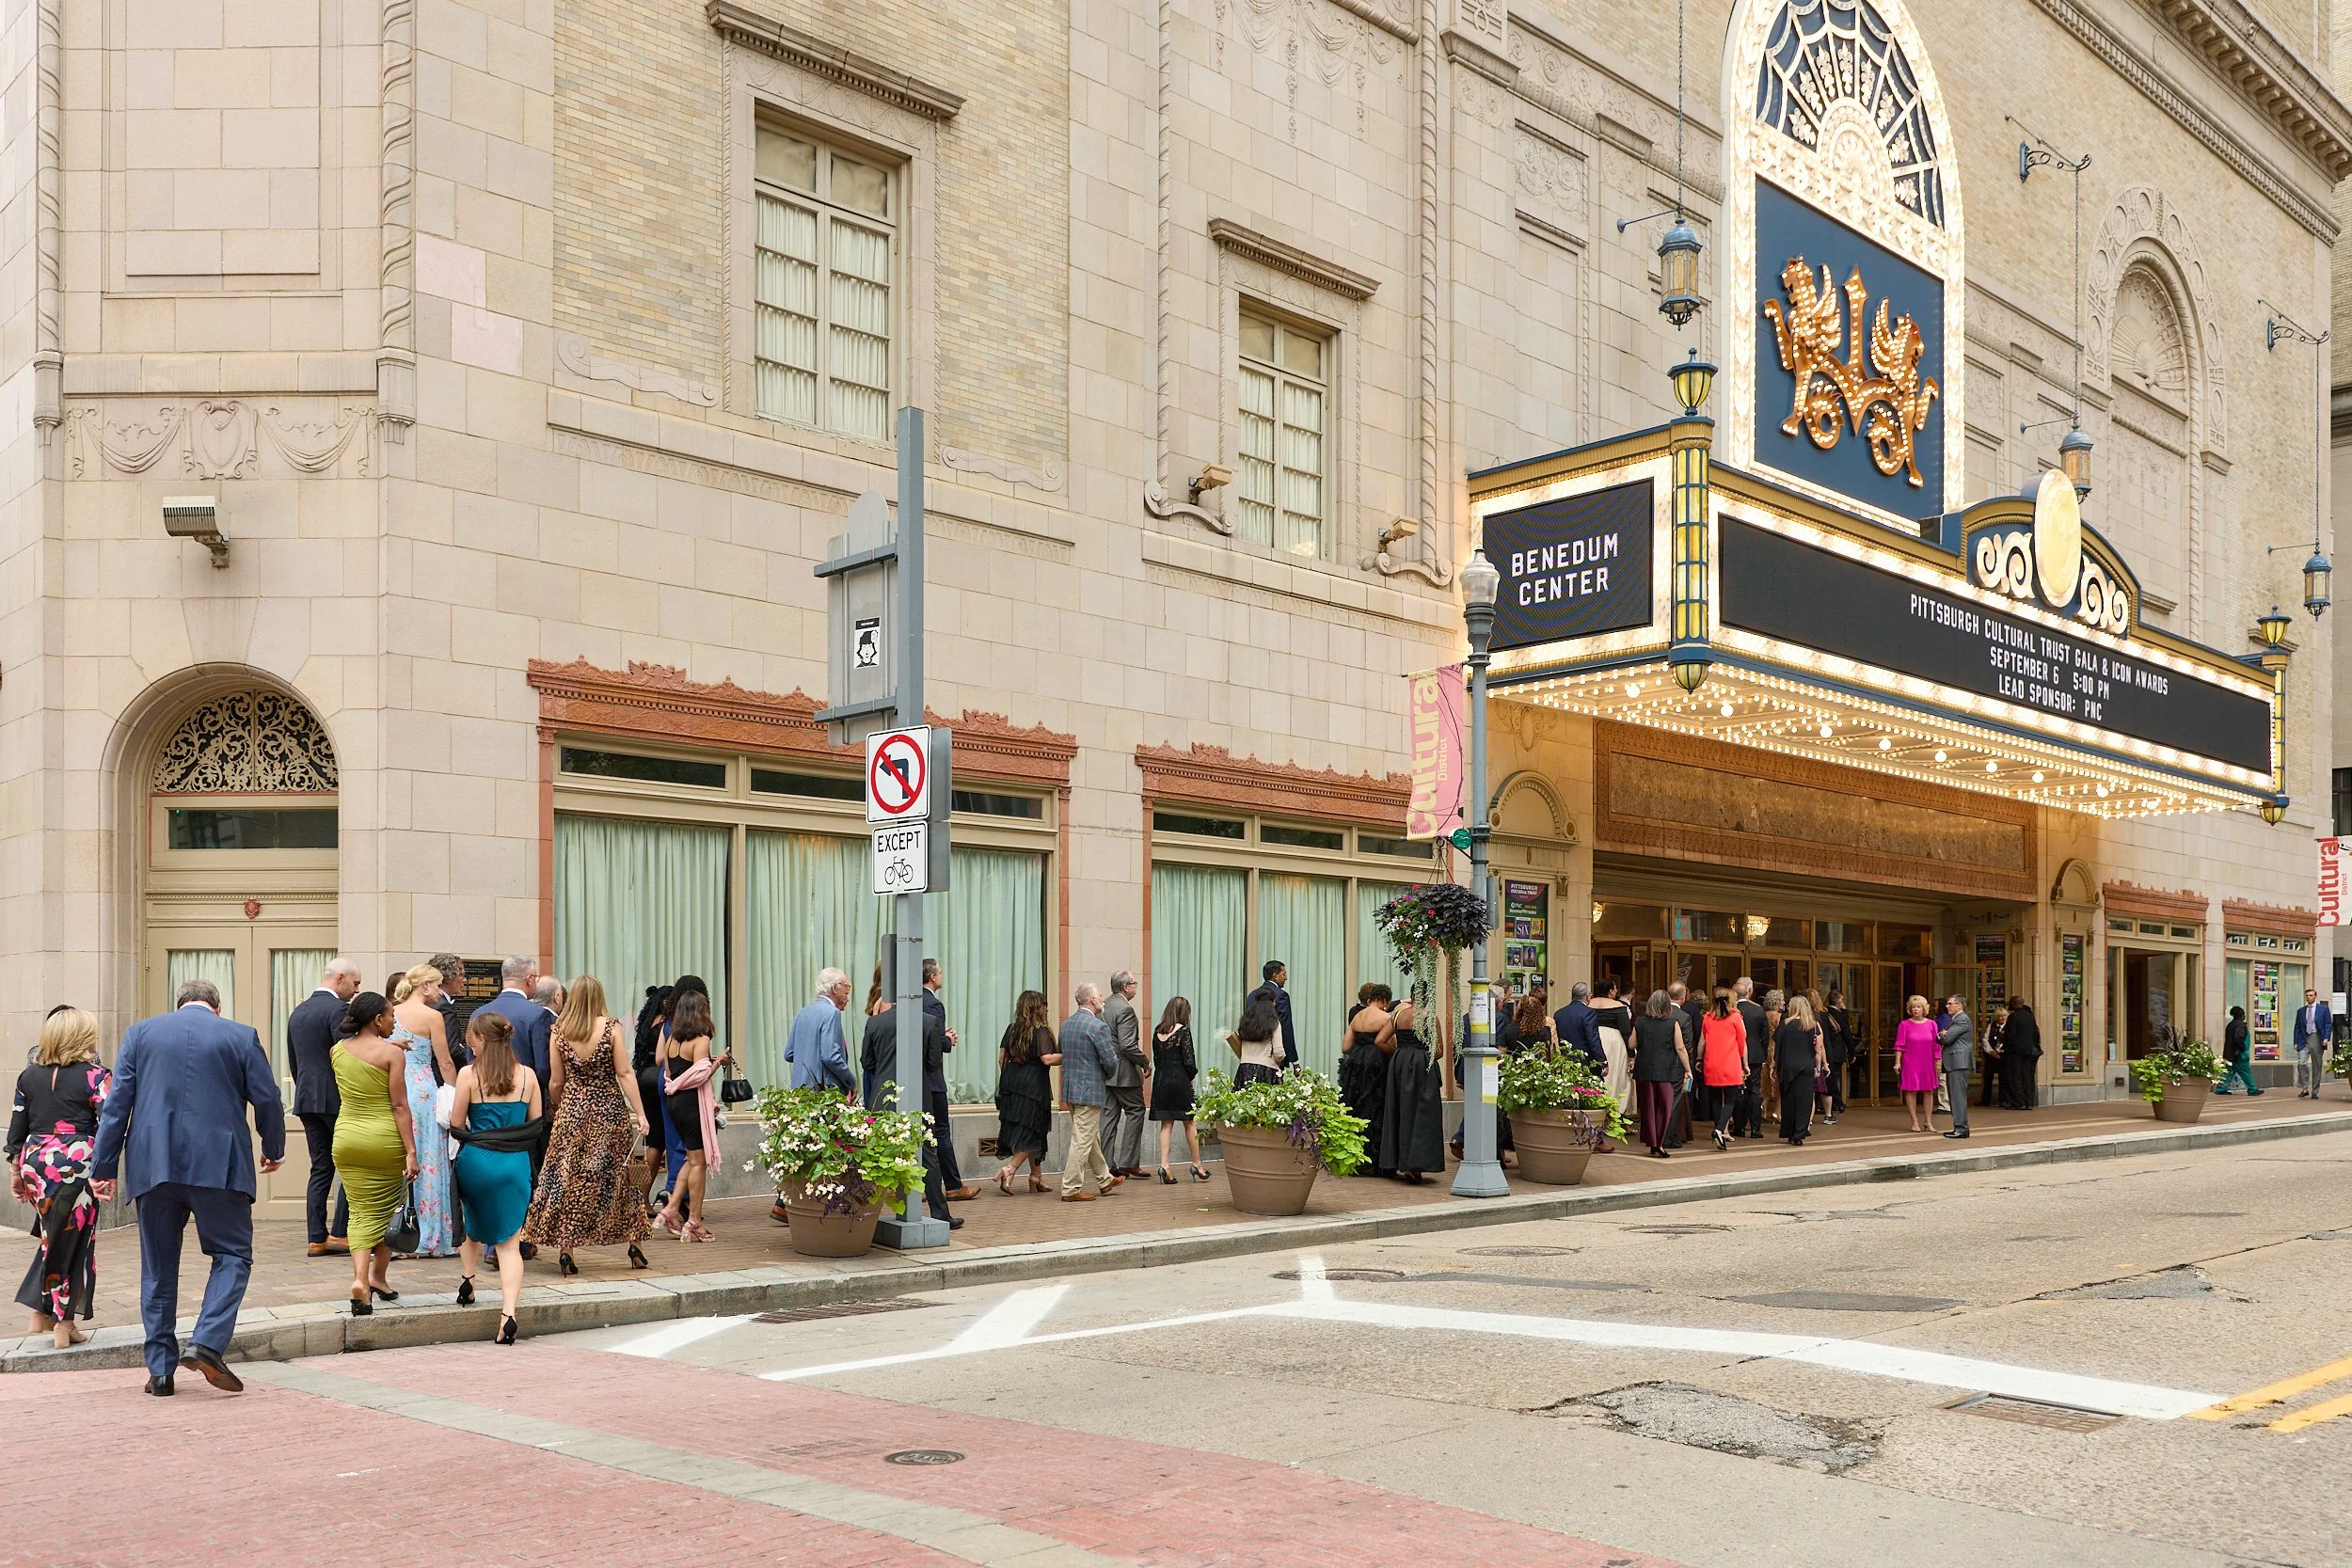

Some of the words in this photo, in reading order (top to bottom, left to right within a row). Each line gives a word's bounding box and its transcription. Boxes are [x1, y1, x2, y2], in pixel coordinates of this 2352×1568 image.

[1511, 533, 1617, 577] BENEDUM
[1518, 567, 1609, 606] CENTER
[1911, 594, 1979, 635] PITTSBURGH
[1984, 619, 2036, 653] CULTURAL
[2040, 637, 2070, 664] TRUST
[2074, 649, 2098, 673] GALA
[2102, 657, 2108, 676] &
[2111, 661, 2131, 684] ICON
[2135, 669, 2169, 695] AWARDS
[1990, 646, 2048, 682] SEPTEMBER
[2053, 665, 2059, 685] 6
[2073, 672, 2093, 695] 5:00
[2097, 679, 2109, 700] PM
[1998, 673, 2025, 699] LEAD
[2029, 683, 2076, 713] SPONSOR:
[2084, 699, 2102, 721] PNC
[1438, 736, 1448, 782] District
[878, 831, 920, 852] EXCEPT
[2317, 836, 2340, 927] Cultural
